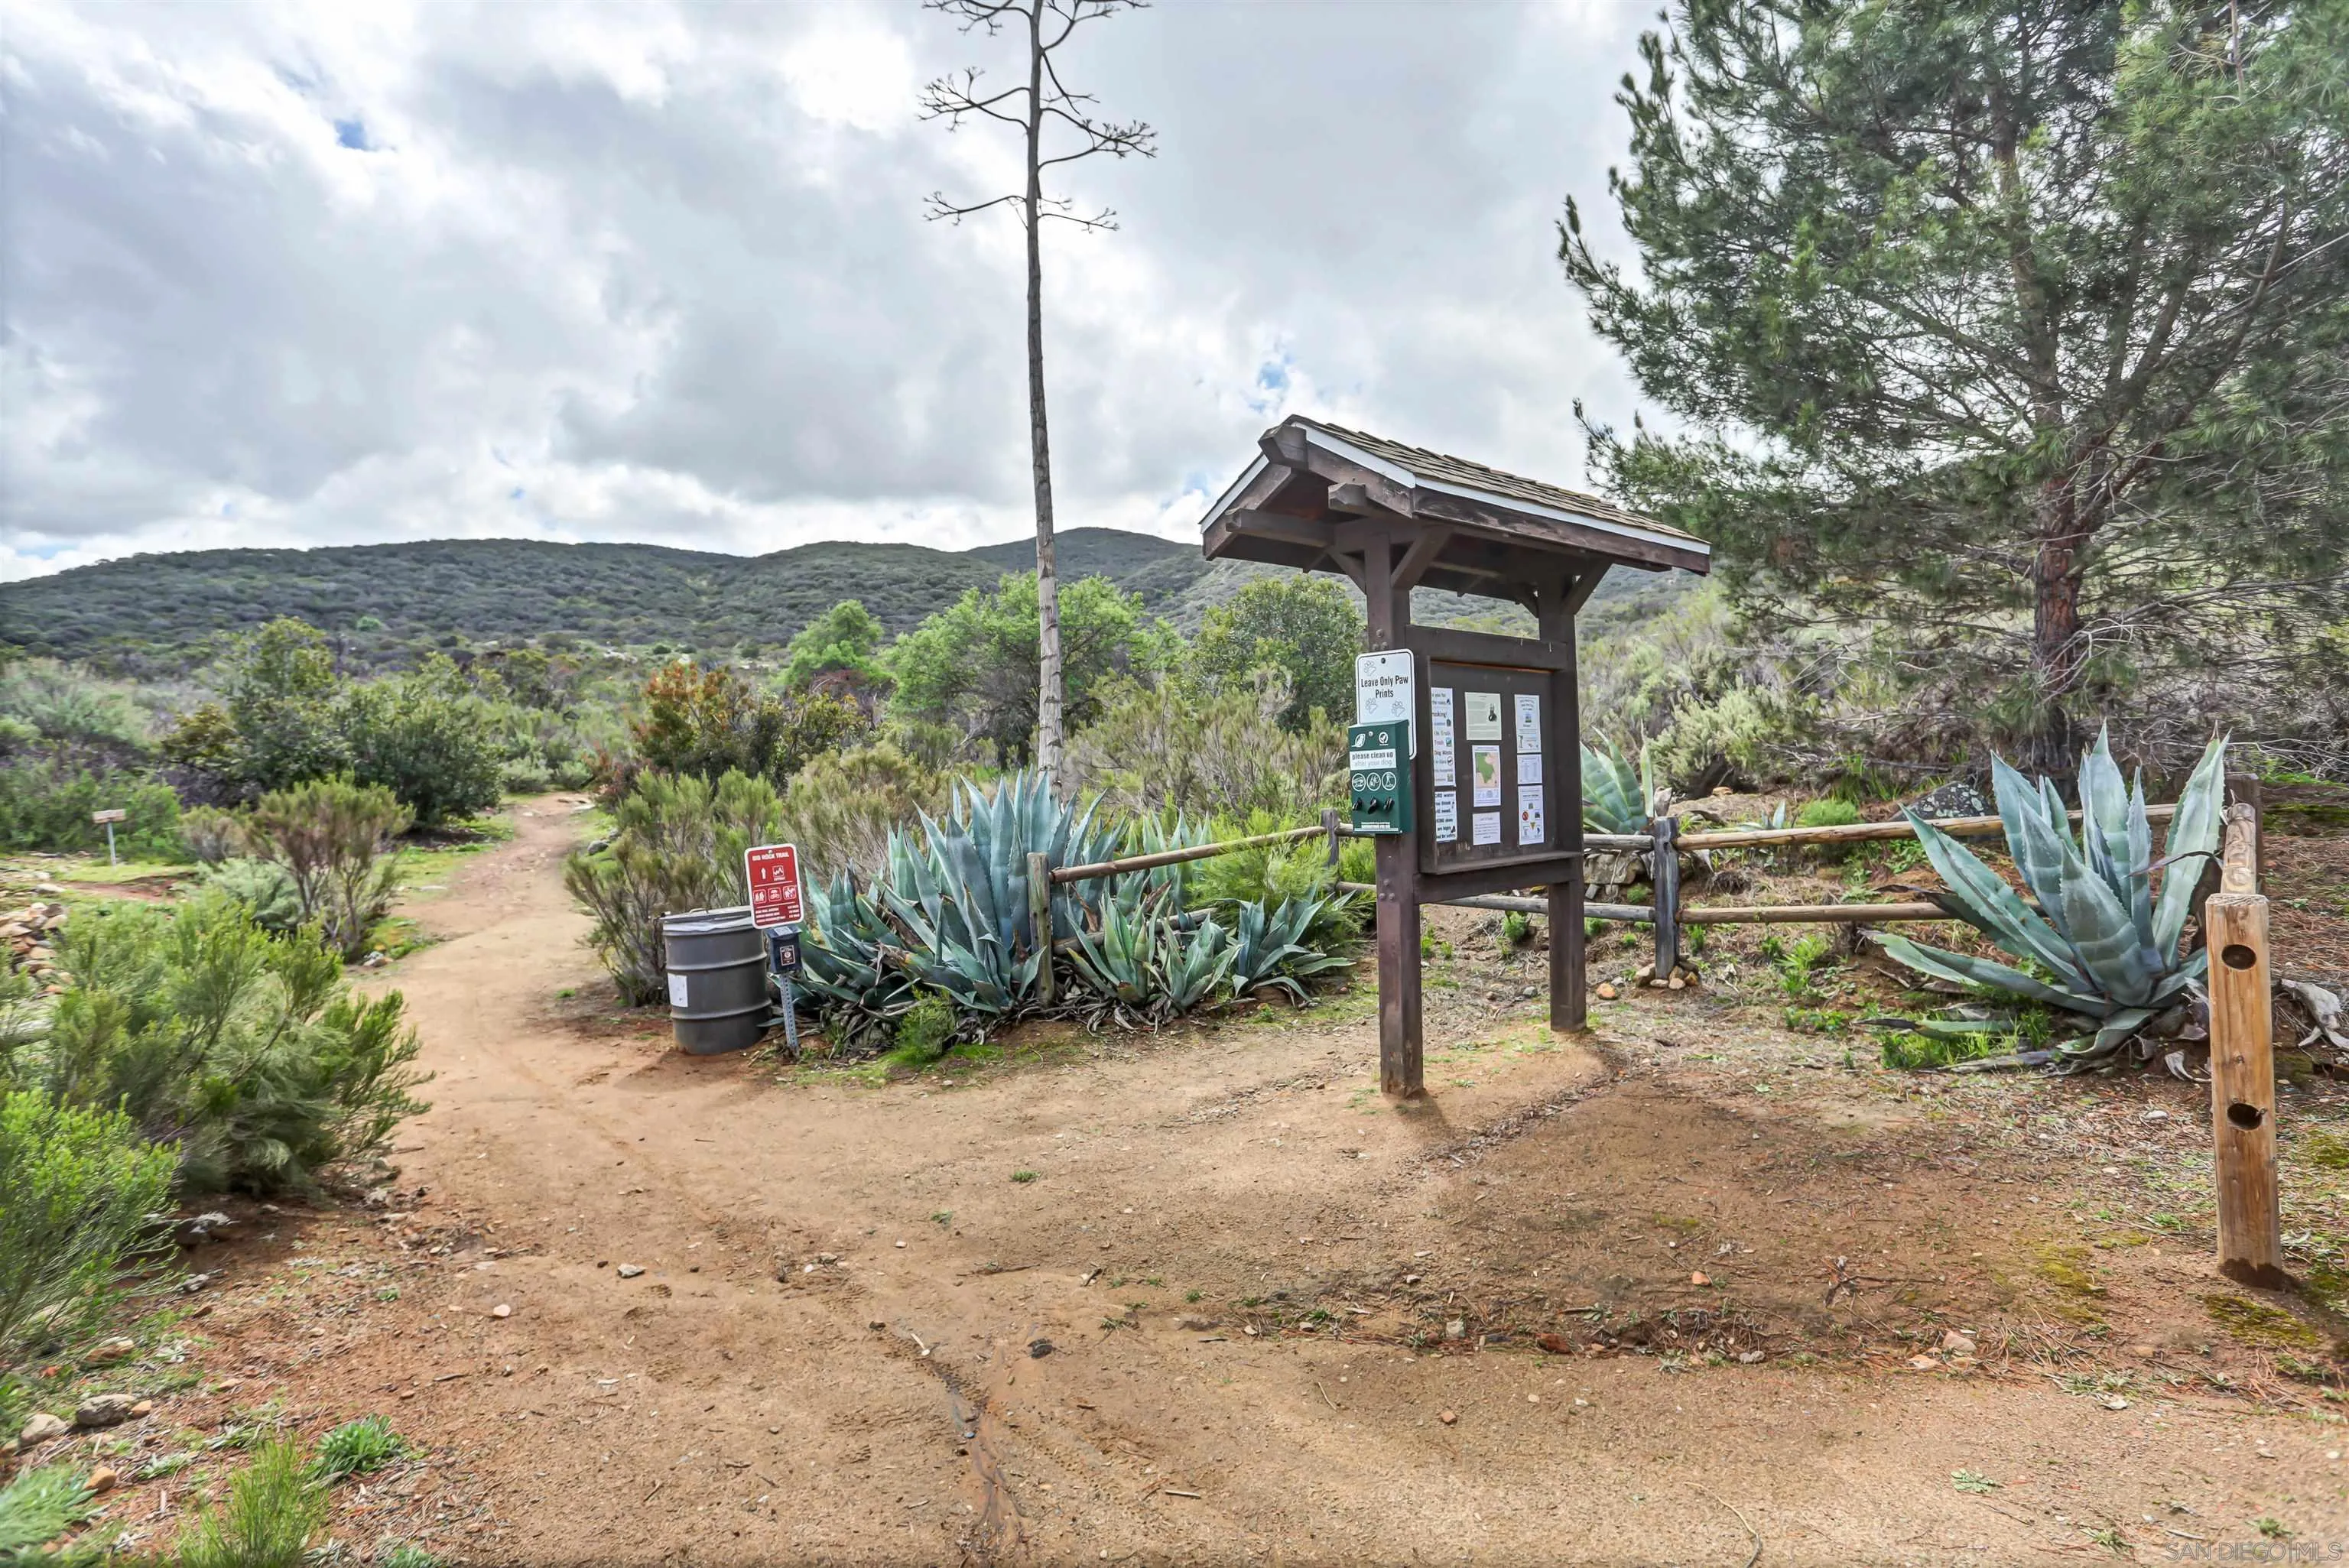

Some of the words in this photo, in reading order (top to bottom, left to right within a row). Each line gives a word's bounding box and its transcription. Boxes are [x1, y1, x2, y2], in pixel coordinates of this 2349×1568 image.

[1361, 678, 1379, 687] Leave
[1379, 676, 1393, 687] Only
[1395, 675, 1408, 685] Paw
[1375, 689, 1394, 699] Prints
[1381, 758, 1392, 767] dog
